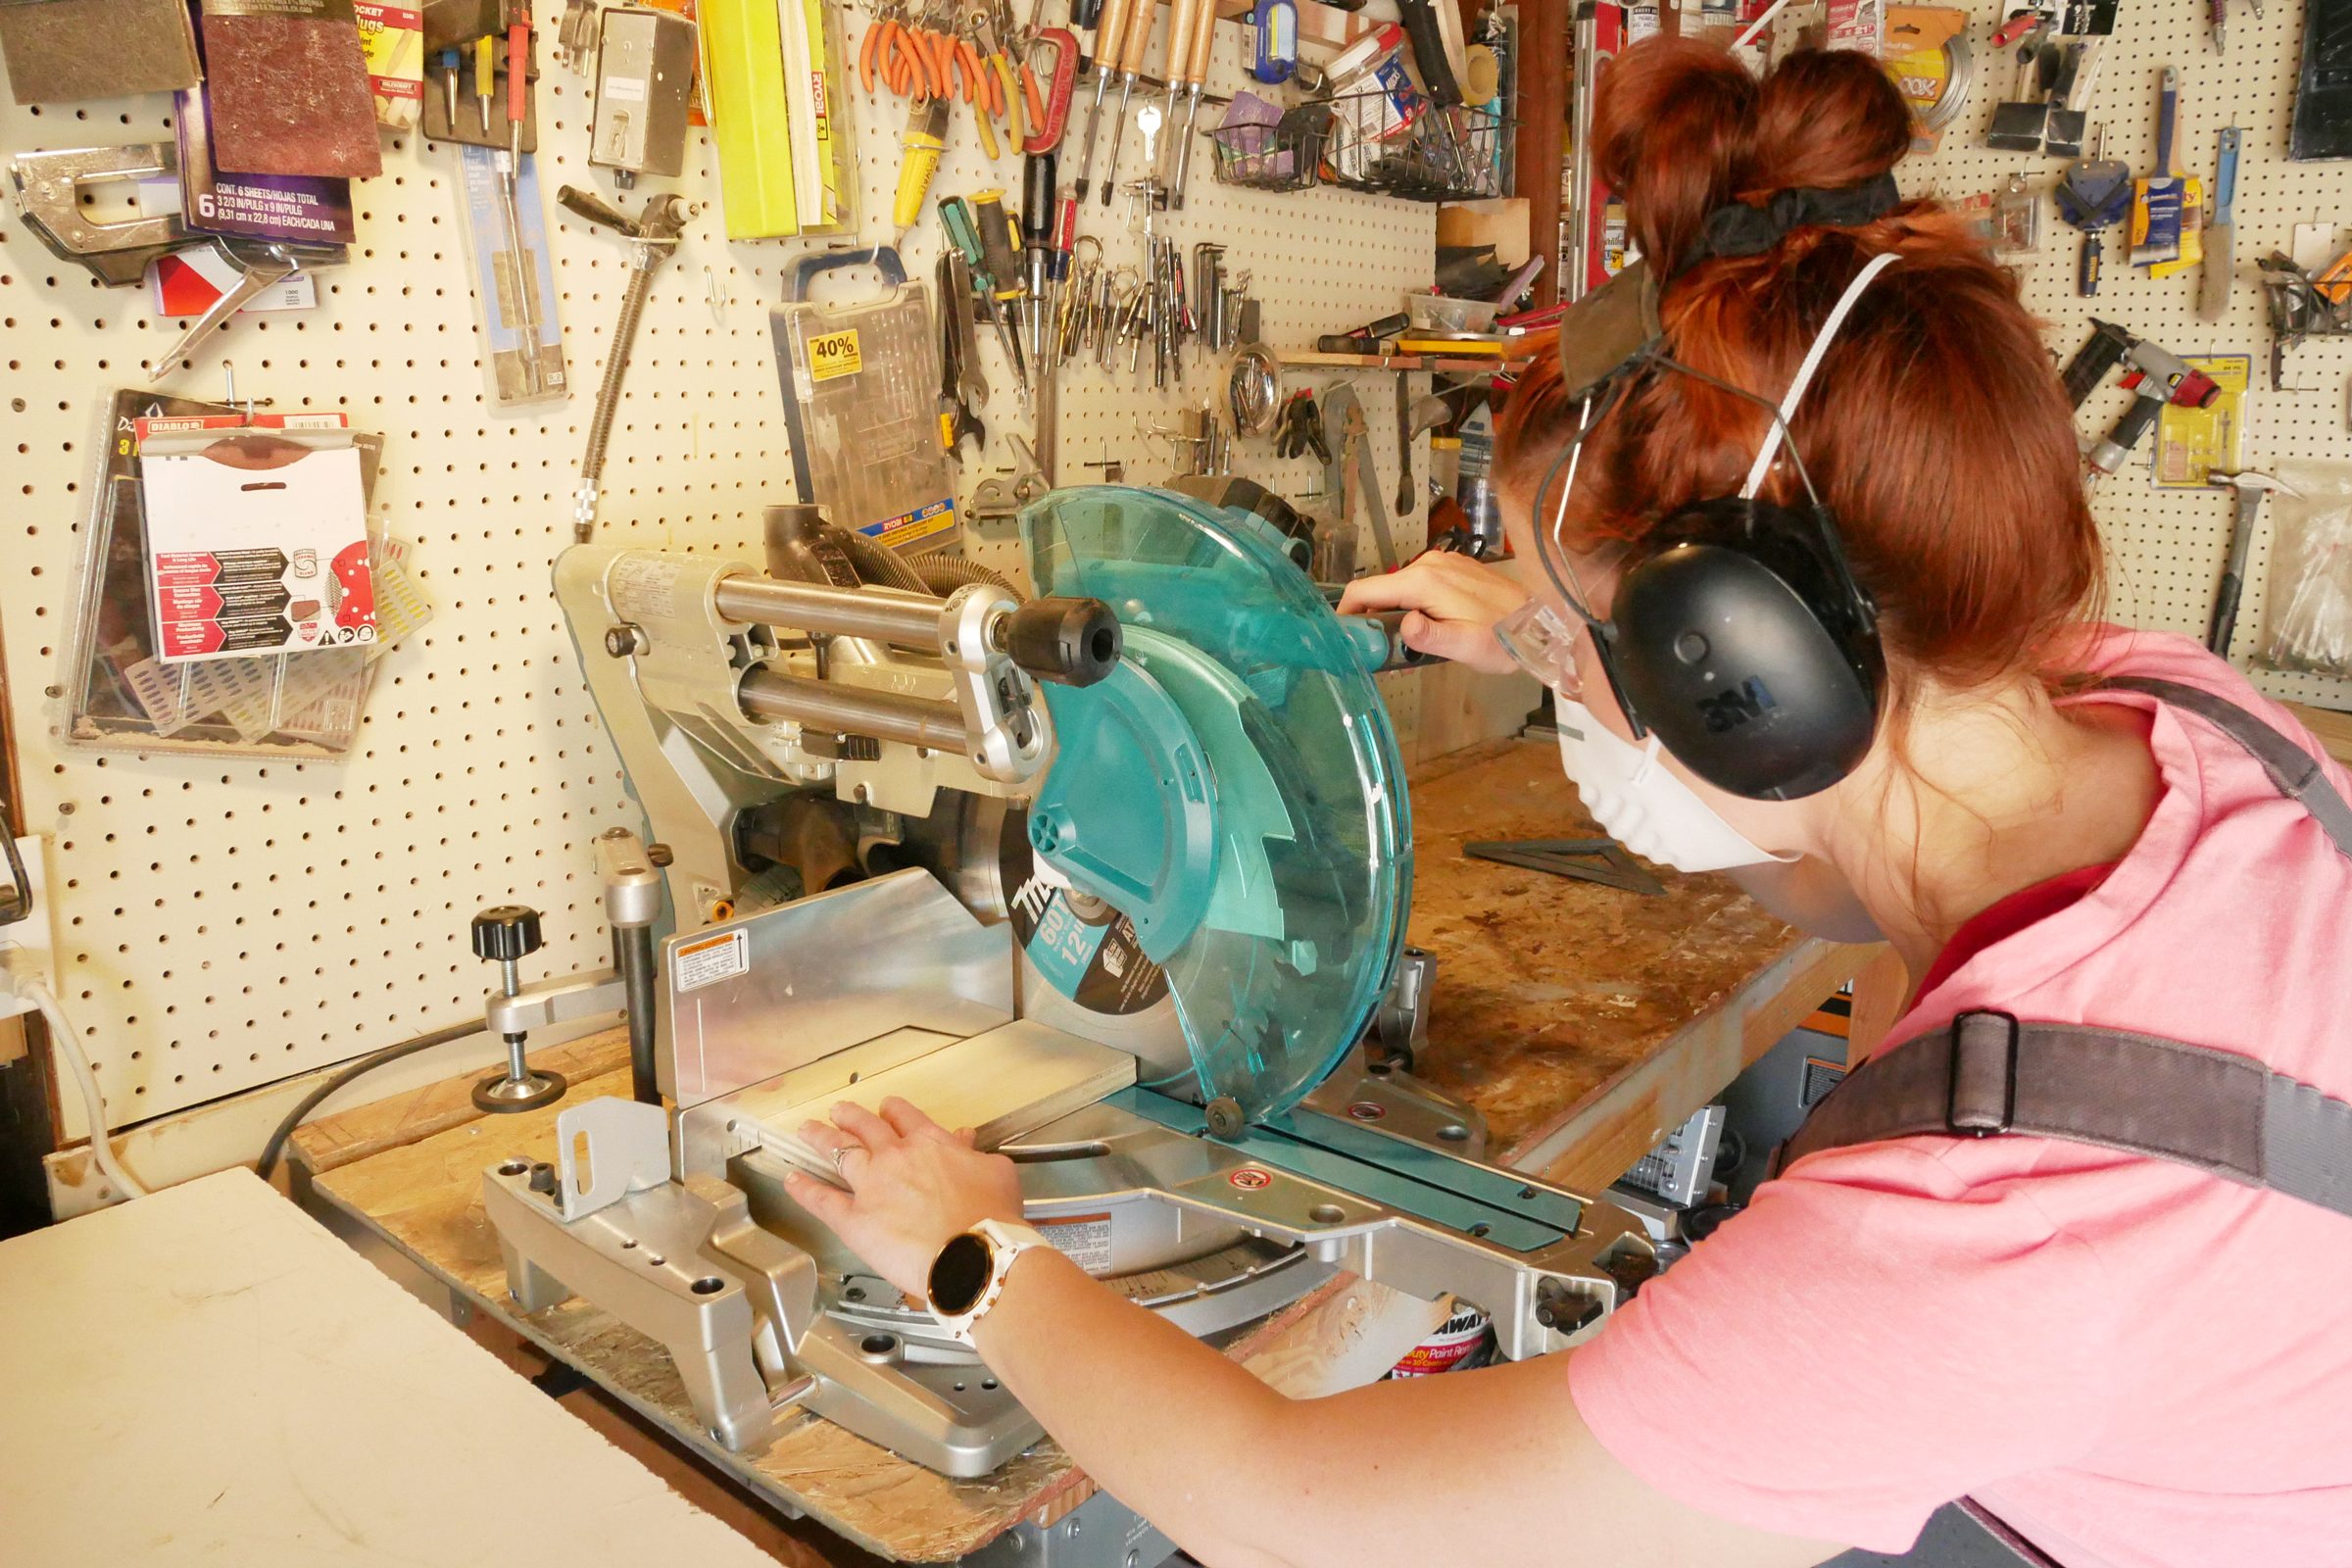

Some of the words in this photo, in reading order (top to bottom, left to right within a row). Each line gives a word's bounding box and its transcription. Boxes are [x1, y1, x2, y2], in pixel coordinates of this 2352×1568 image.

[812, 74, 824, 114] RYOBI
[217, 182, 237, 195] CONT.
[238, 186, 243, 196] 6
[244, 186, 296, 202] SHEETS/HOJAS
[297, 192, 318, 206] TOTAL
[199, 194, 215, 218] 6
[218, 196, 222, 206] 3
[223, 197, 235, 208] 2/3
[236, 199, 264, 211] IN/PULG
[270, 203, 274, 213] 9
[275, 203, 303, 216] IN/PULG
[235, 212, 246, 221] cm
[254, 213, 269, 225] 22,8
[270, 215, 281, 227] cm)
[282, 216, 320, 230] EACH/CADA
[320, 220, 335, 231] UNA
[816, 336, 854, 358] 40%
[151, 421, 190, 431] DIABLO
[119, 439, 128, 456] 3
[884, 518, 902, 530] RYOBI
[1040, 892, 1071, 946] 60T
[1430, 1348, 1453, 1359] Paint
